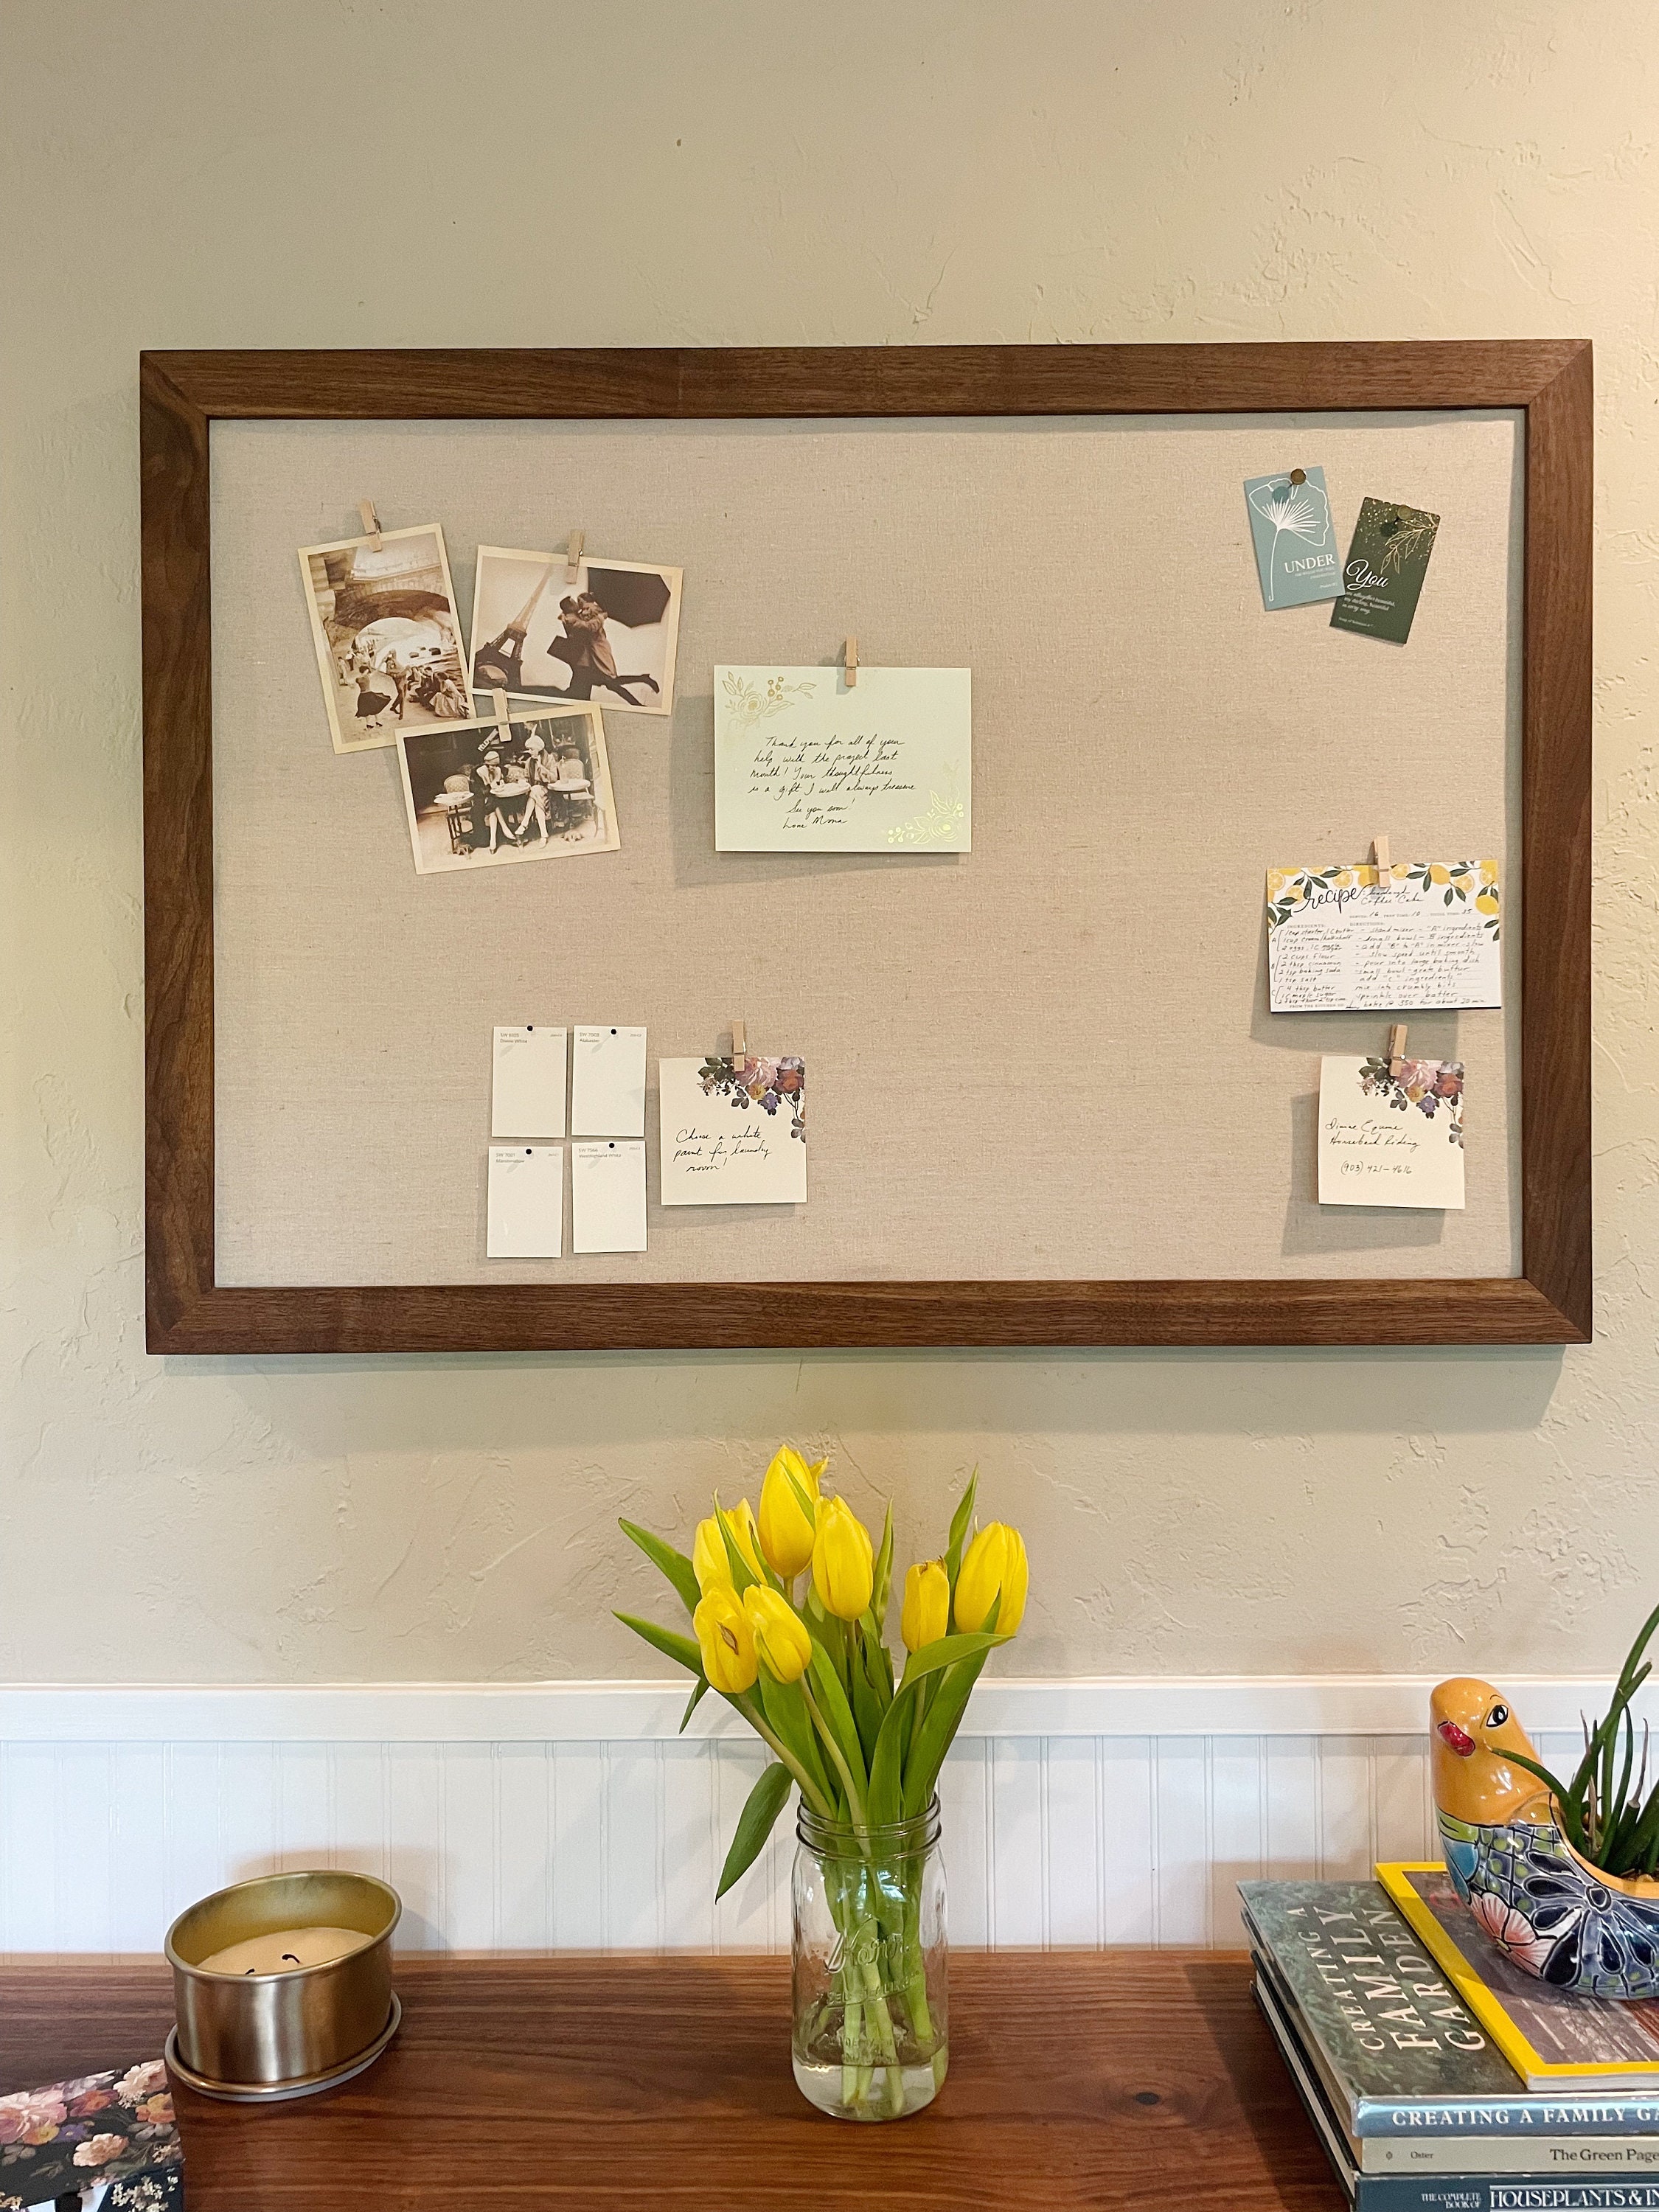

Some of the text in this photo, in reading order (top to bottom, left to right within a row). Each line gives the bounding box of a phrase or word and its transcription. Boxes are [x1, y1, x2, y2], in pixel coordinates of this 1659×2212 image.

[1284, 554, 1335, 574] UNDER
[1346, 559, 1389, 591] You
[765, 734, 905, 752] Thank you for all of your
[754, 749, 899, 768] help with the project last
[792, 766, 816, 780] Your
[774, 782, 802, 801] gift
[804, 783, 815, 796] I
[818, 779, 841, 793] will
[846, 781, 879, 796] always
[880, 778, 917, 791] treasure
[807, 806, 822, 820] you
[1398, 892, 1424, 903] Cake
[676, 1127, 712, 1143] Choose
[731, 1125, 763, 1139] white
[1329, 1131, 1421, 1152] Horseback Riding
[672, 1139, 772, 1162] paint for laundry
[1341, 1161, 1364, 1175] (903)
[1287, 1907, 1385, 2051] CREATING A
[1313, 1905, 1442, 2051] FAMILY
[1362, 1908, 1486, 2051] GARDEN
[1392, 2109, 1510, 2126] CREATING
[1520, 2109, 1534, 2124] A
[1543, 2107, 1625, 2124] FAMILY
[1411, 2148, 1659, 2163] Oster The Green Page
[1421, 2193, 1437, 2202] THE
[1437, 2192, 1481, 2202] COMPLETE
[1490, 2189, 1624, 2208] HOUSEPLANTS
[1628, 2189, 1643, 2207] &
